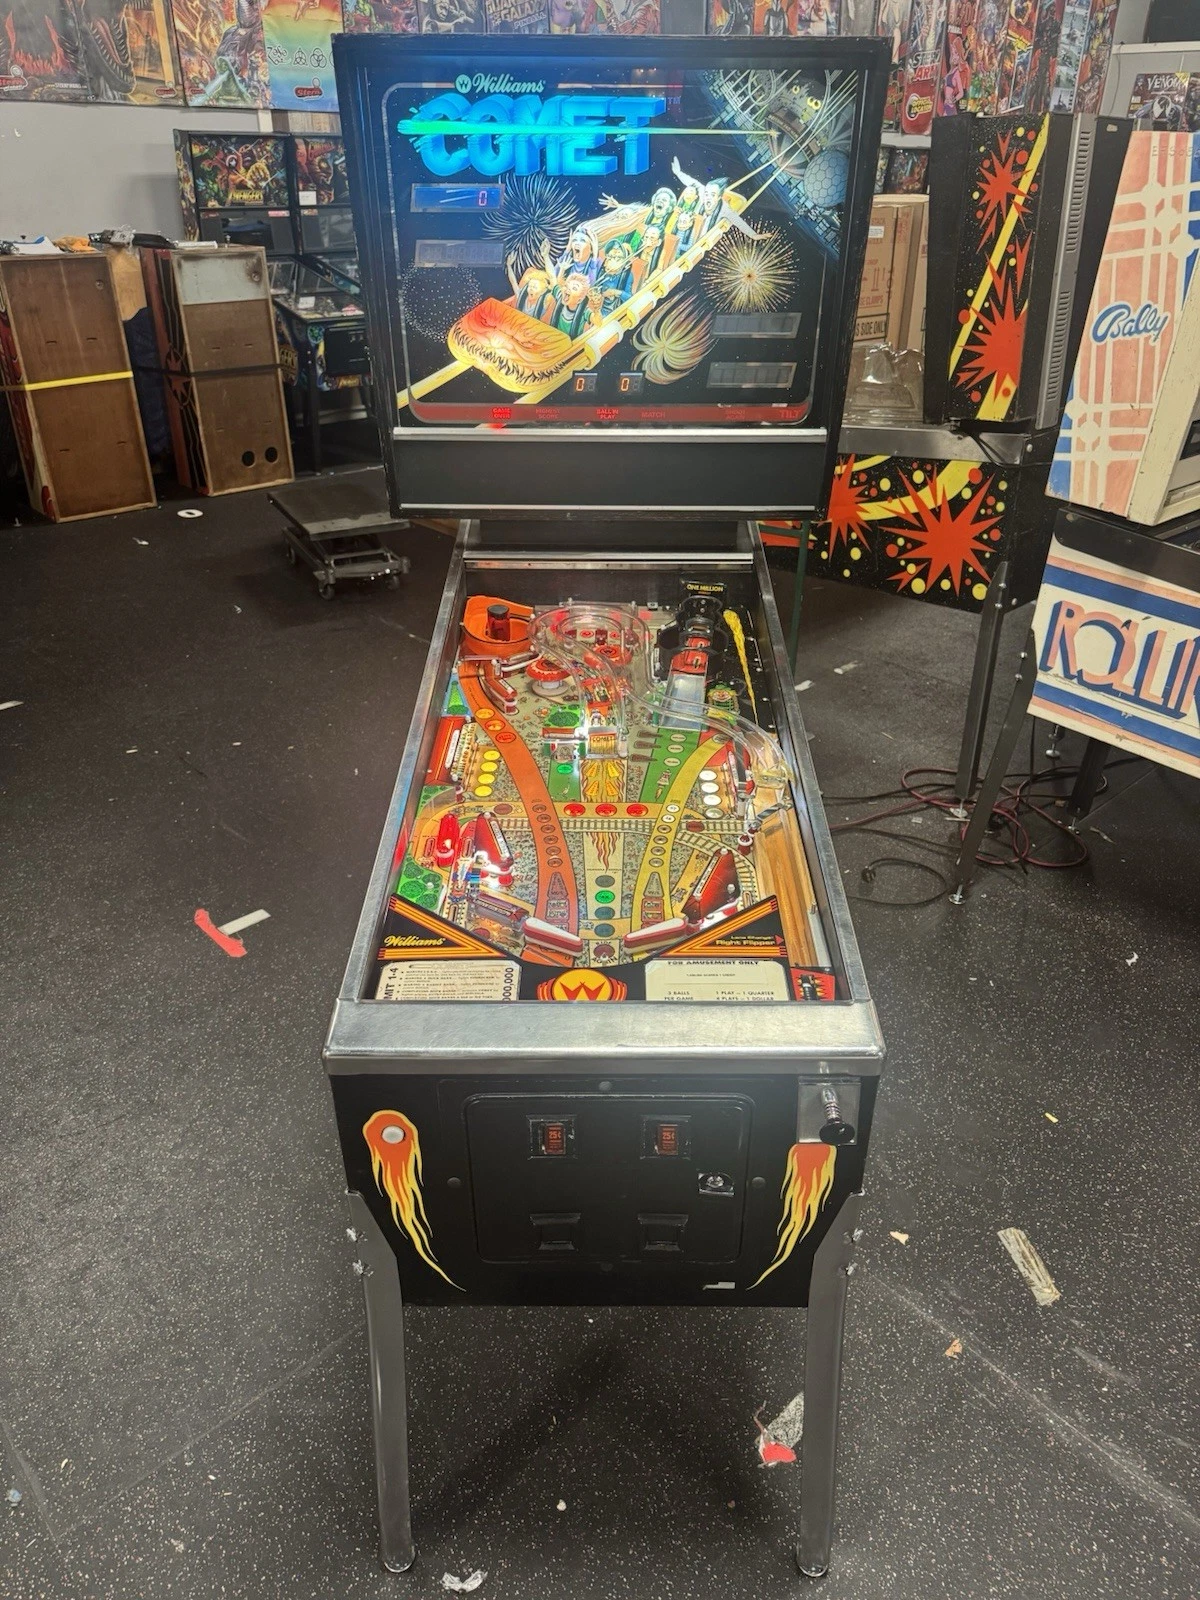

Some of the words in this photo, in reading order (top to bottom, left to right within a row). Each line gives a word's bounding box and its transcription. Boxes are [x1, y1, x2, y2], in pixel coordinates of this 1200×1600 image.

[472, 73, 545, 93] Williams
[411, 93, 667, 176] COMET
[861, 321, 874, 336] SIDE
[1092, 303, 1169, 343] Bally
[779, 409, 800, 418] TILT
[383, 935, 446, 947] Williams
